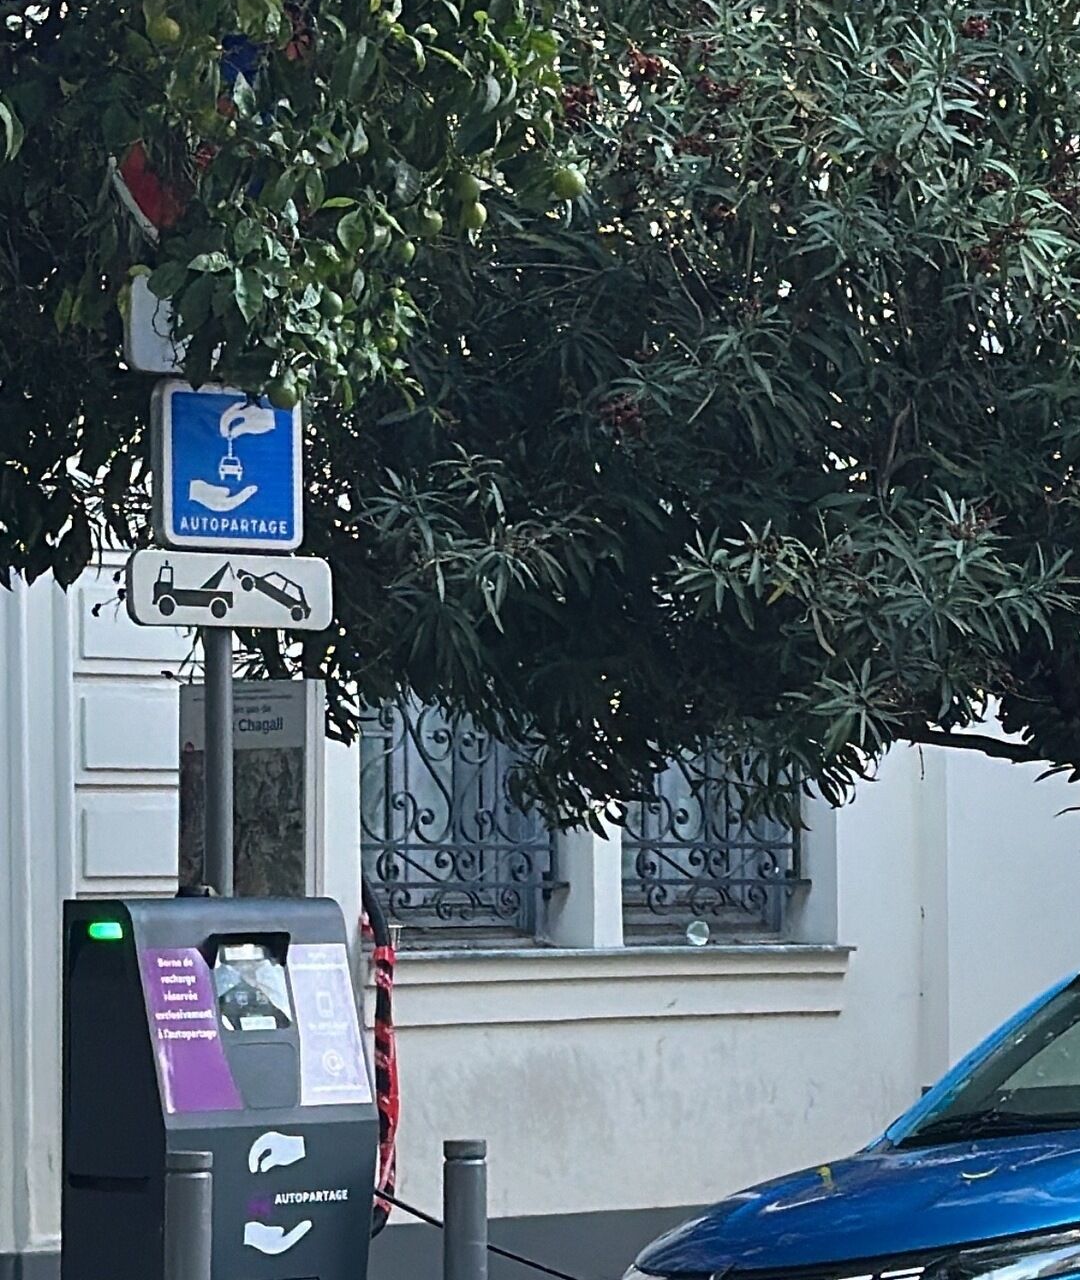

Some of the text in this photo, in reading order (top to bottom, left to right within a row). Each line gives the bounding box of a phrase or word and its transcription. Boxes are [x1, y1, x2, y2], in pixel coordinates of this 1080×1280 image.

[180, 517, 288, 535] AUTOPARTAGE
[238, 717, 284, 735] Chagall
[274, 1189, 349, 1205] AUTOPARTAGE
